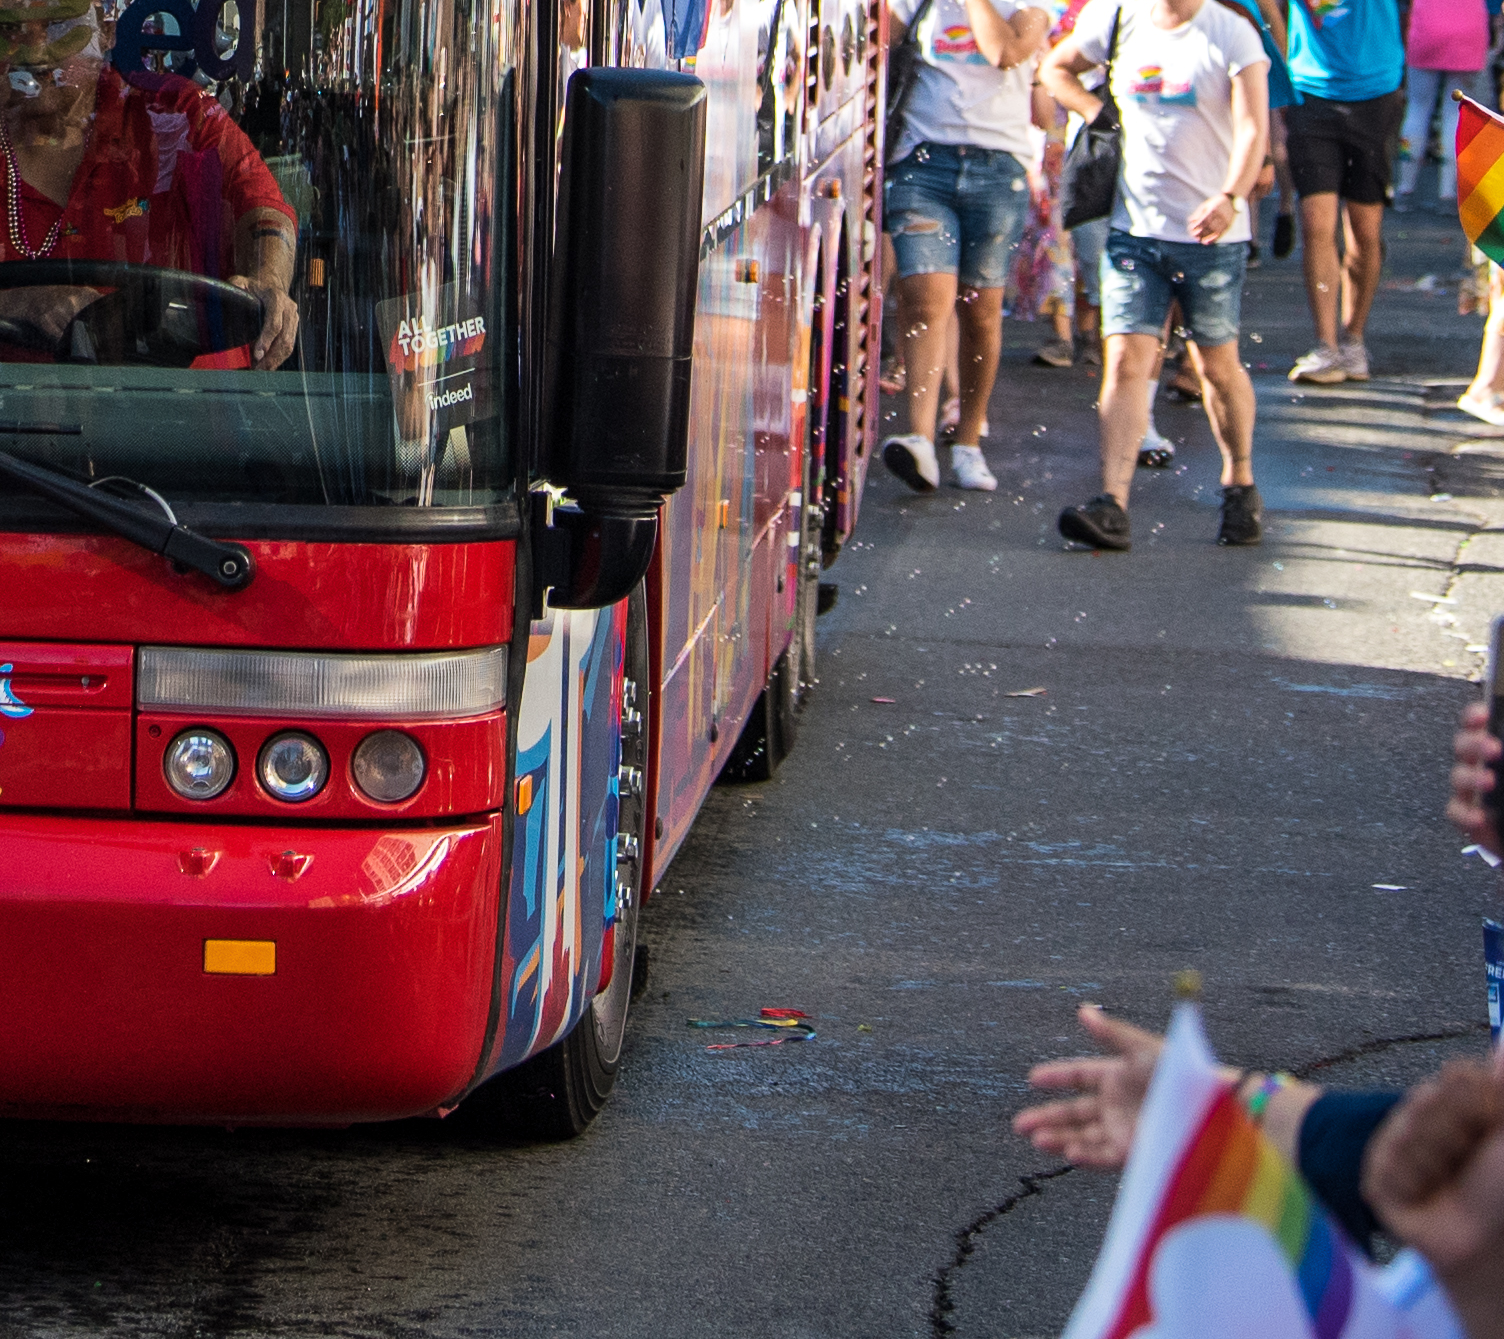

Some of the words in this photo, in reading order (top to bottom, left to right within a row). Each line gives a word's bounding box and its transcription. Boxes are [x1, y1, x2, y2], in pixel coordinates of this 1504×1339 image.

[398, 315, 432, 339] ALL
[398, 316, 486, 357] TOGETHER
[425, 383, 472, 410] indeed
